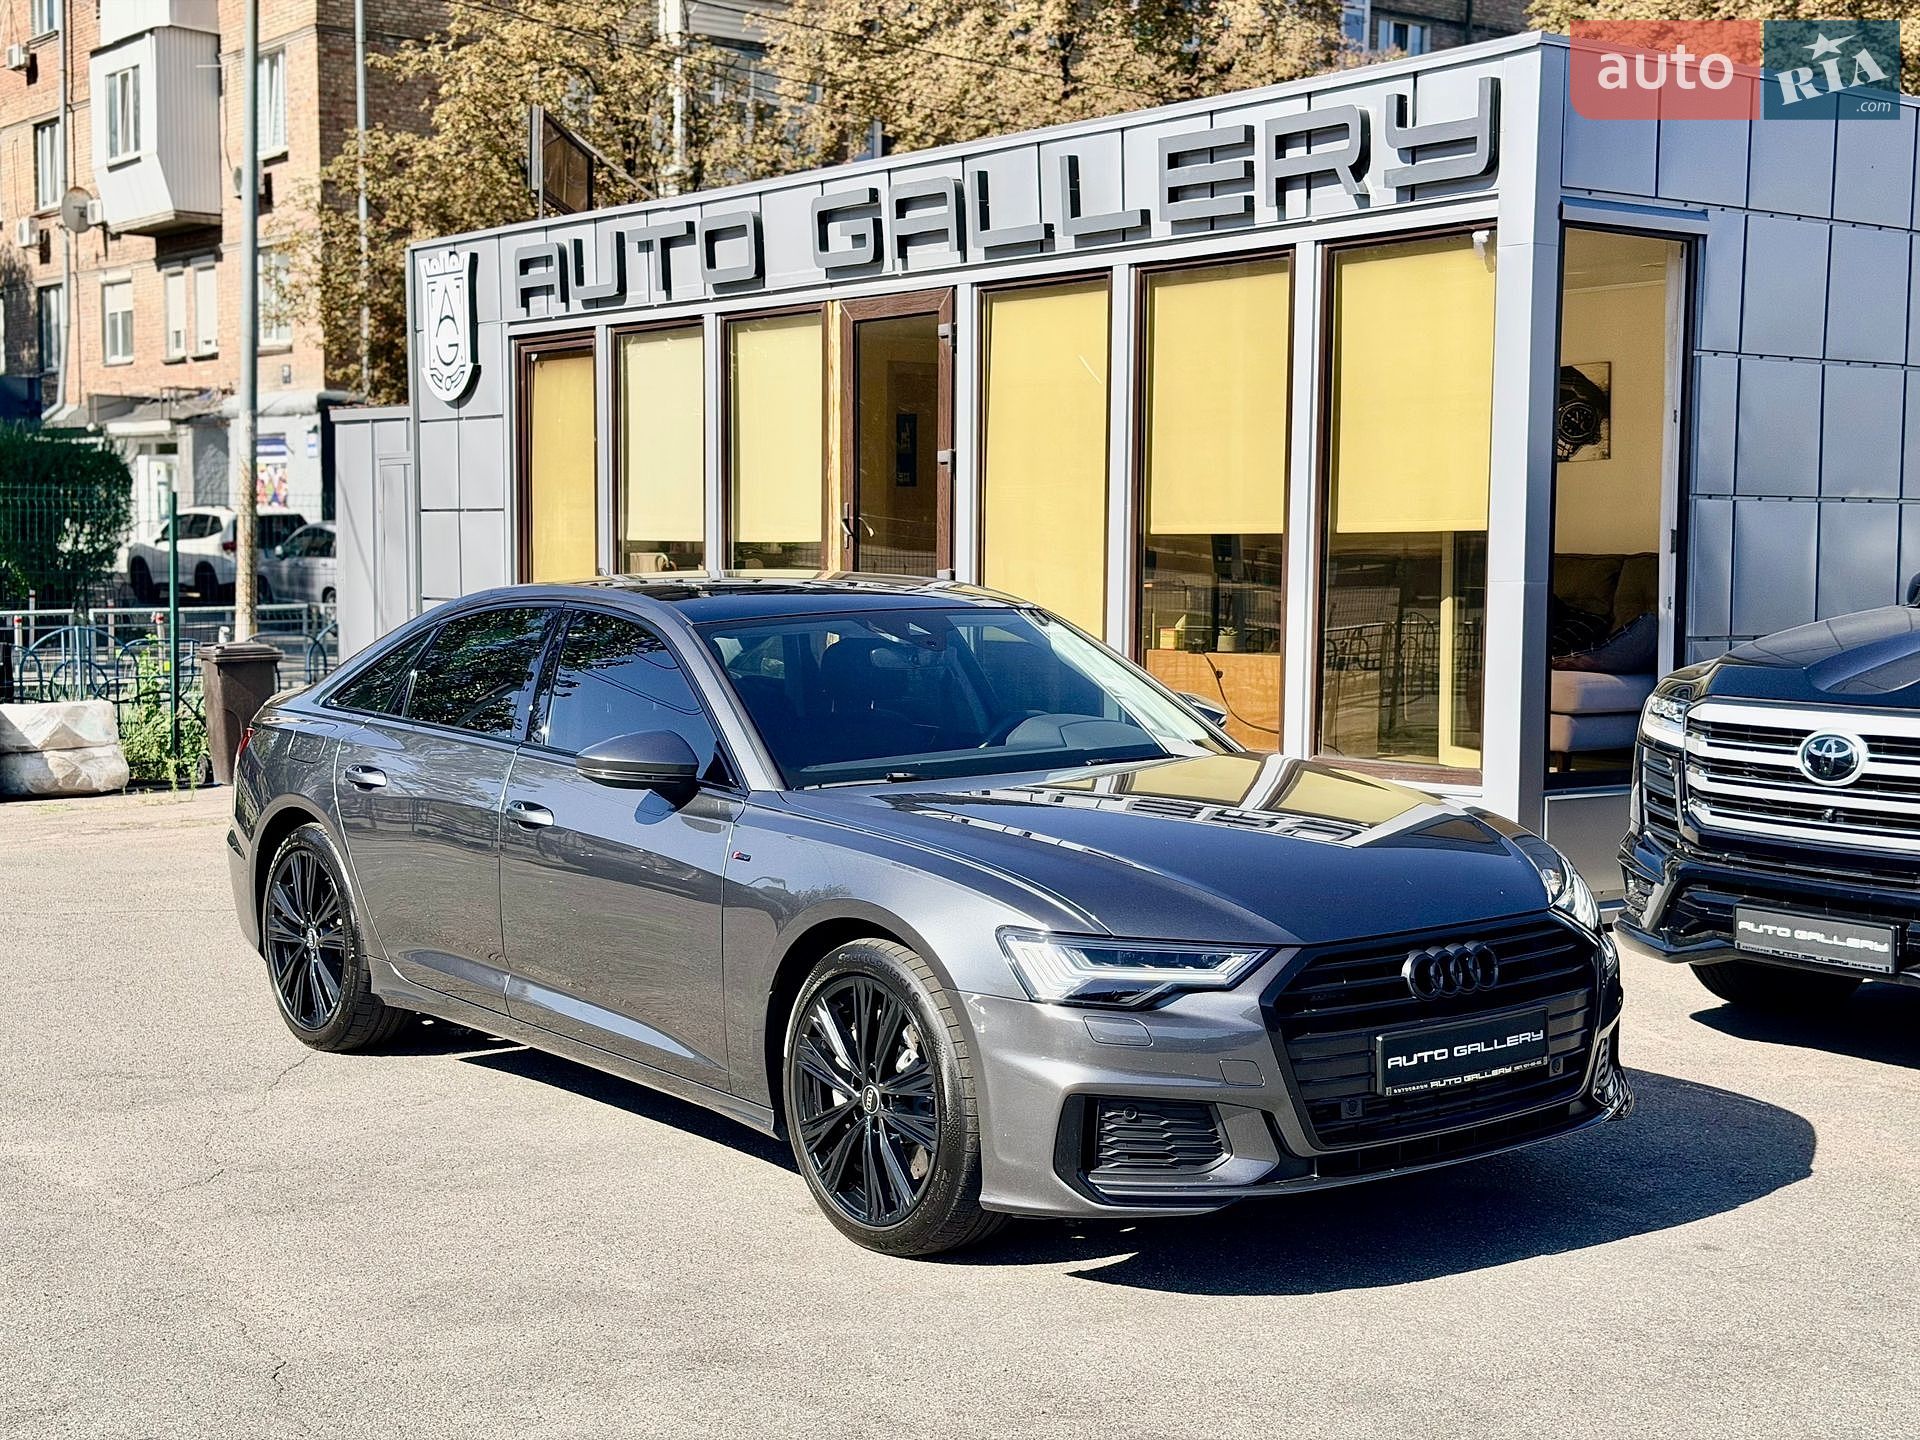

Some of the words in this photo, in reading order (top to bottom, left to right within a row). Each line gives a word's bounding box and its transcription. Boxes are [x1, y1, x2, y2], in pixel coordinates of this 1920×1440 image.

[514, 210, 765, 312] AUTO
[811, 76, 1501, 269] GALLERY
[1738, 921, 1791, 938] AUTO
[1794, 929, 1889, 953] GALLERY
[1387, 1048, 1448, 1069] AUTO
[1453, 1029, 1544, 1057] GALLERY
[1430, 1076, 1462, 1089] AUTO
[1463, 1066, 1512, 1082] GALLERY
